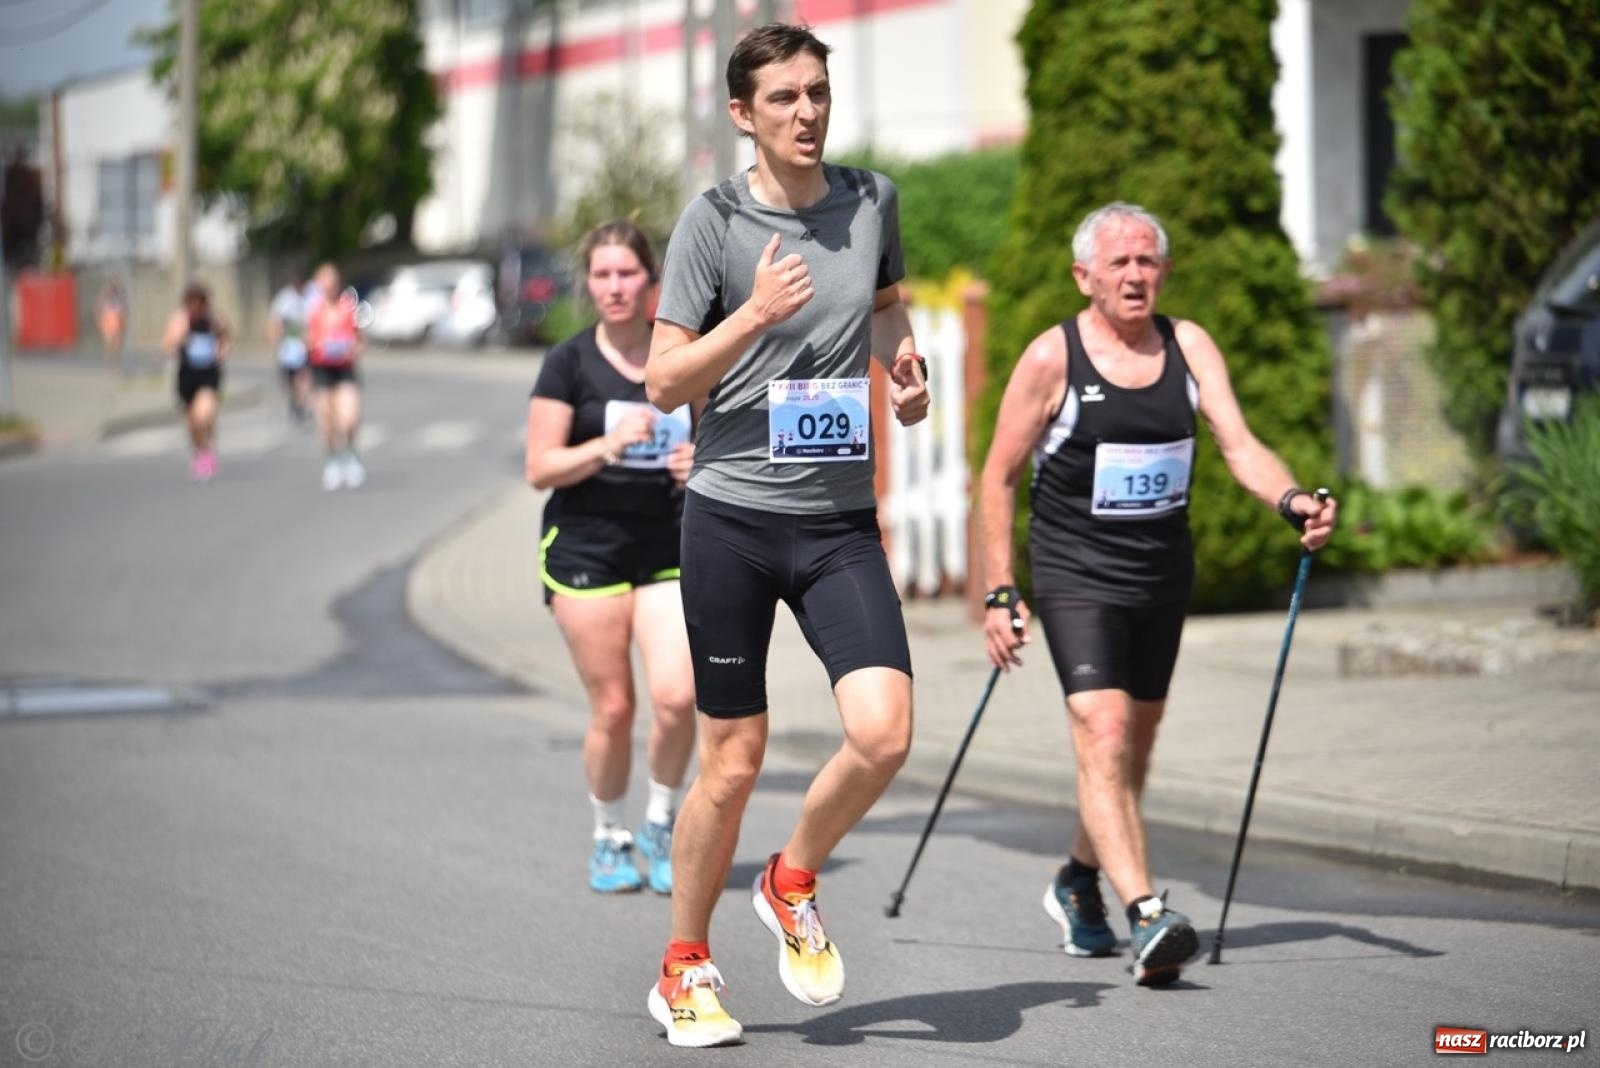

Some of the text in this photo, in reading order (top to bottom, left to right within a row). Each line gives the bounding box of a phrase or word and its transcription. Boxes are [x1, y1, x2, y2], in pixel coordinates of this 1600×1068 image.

[820, 382, 837, 390] BEZ
[798, 412, 850, 440] 029
[1123, 472, 1169, 495] 139
[709, 656, 737, 664] CRAFT
